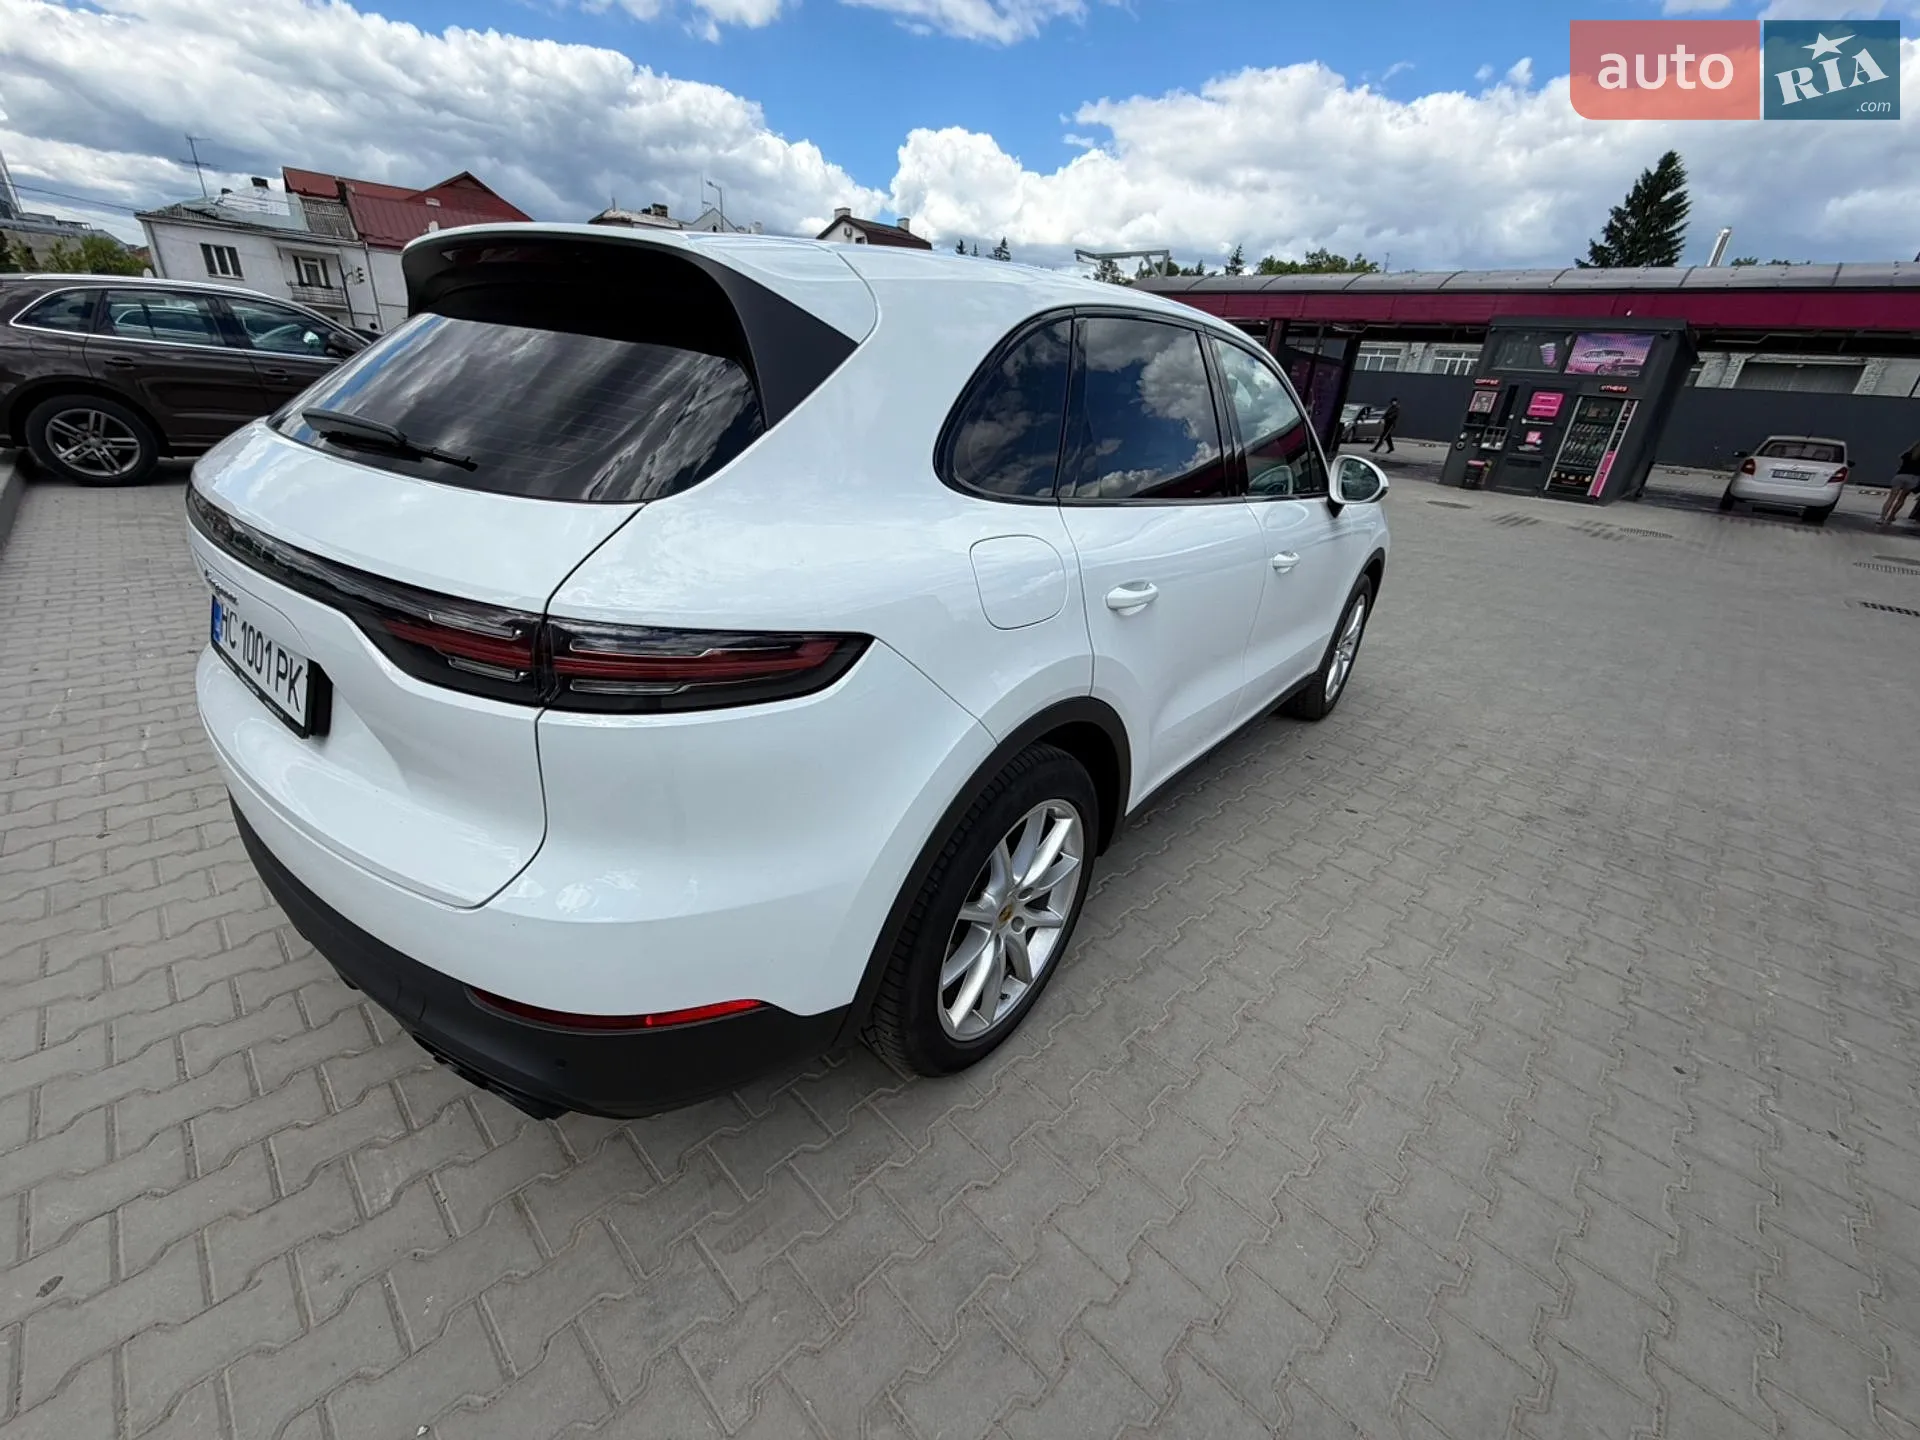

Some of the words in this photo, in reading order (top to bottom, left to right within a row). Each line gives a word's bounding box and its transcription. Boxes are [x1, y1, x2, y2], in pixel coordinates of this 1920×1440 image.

[222, 607, 238, 649] HC
[241, 621, 272, 685] 1001
[275, 650, 303, 713] PK
